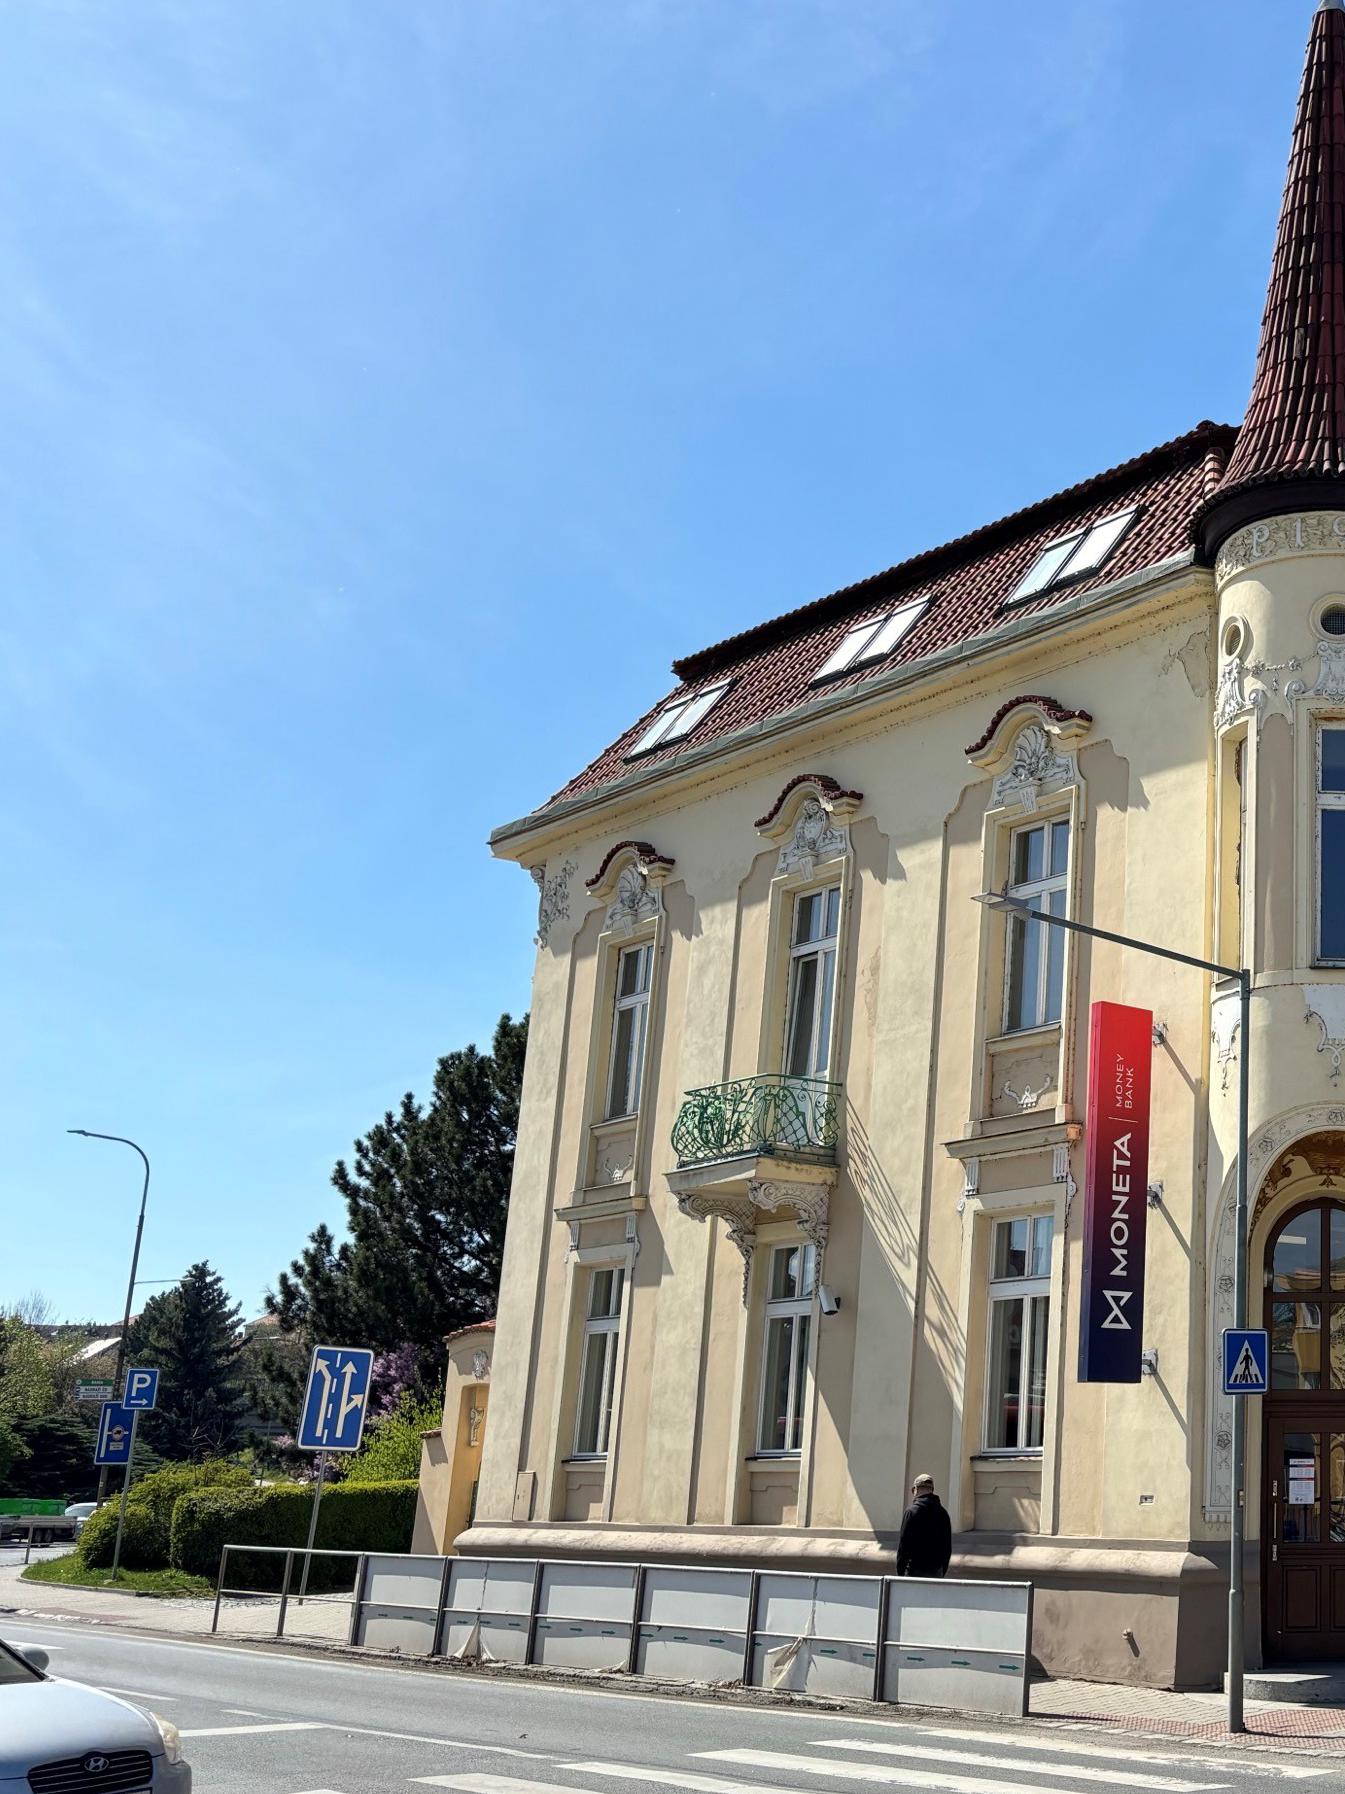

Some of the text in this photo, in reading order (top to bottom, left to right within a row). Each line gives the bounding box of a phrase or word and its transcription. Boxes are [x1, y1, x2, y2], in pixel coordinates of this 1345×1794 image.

[1115, 1053, 1125, 1107] MONEY
[1124, 1067, 1134, 1109] BANK
[1109, 1132, 1132, 1276] MONETA
[131, 1373, 151, 1396] P
